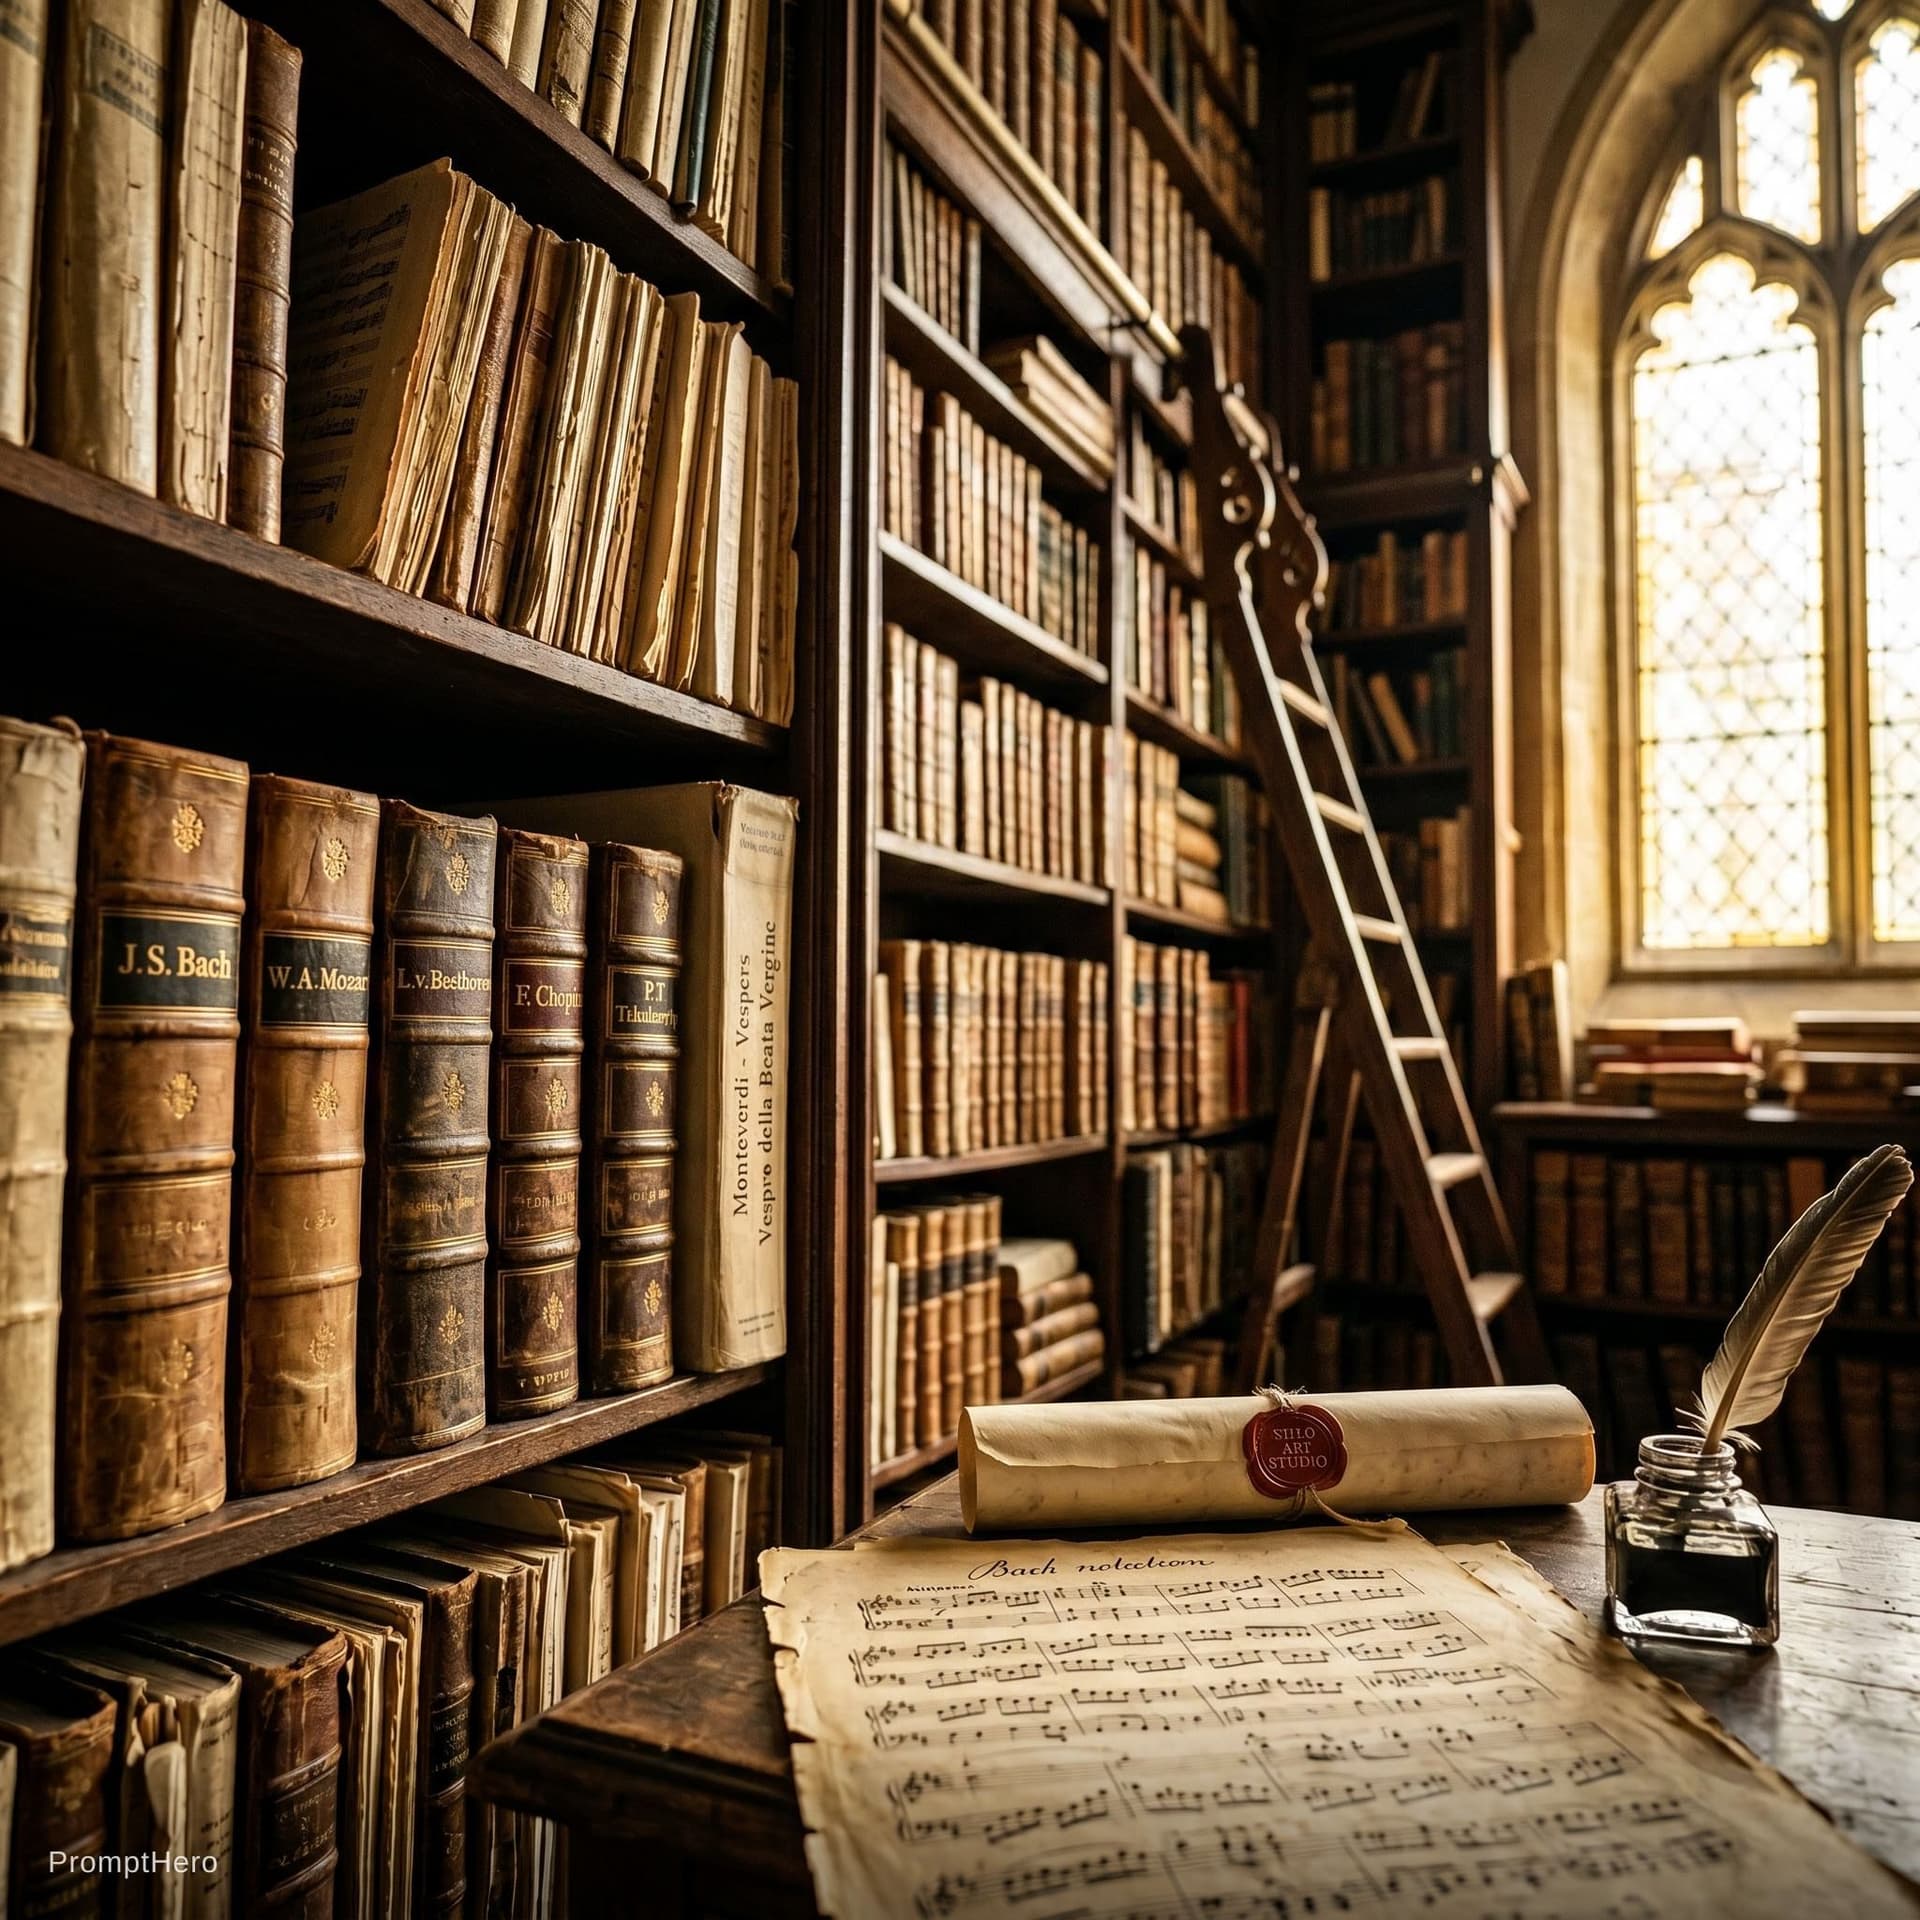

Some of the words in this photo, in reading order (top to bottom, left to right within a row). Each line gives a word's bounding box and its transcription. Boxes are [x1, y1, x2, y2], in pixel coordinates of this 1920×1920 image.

[176, 946, 232, 980] Bach
[760, 920, 782, 1011] Vergine
[513, 984, 531, 1007] F.
[735, 953, 754, 1047] Vespers
[759, 1021, 774, 1087] Beata
[733, 1078, 749, 1216] Monteverdi
[758, 1098, 773, 1153] della
[759, 1168, 776, 1246] Vespro
[1267, 1454, 1328, 1470] STUDIO
[1282, 1441, 1312, 1455] ART
[967, 1557, 1057, 1581] Bach
